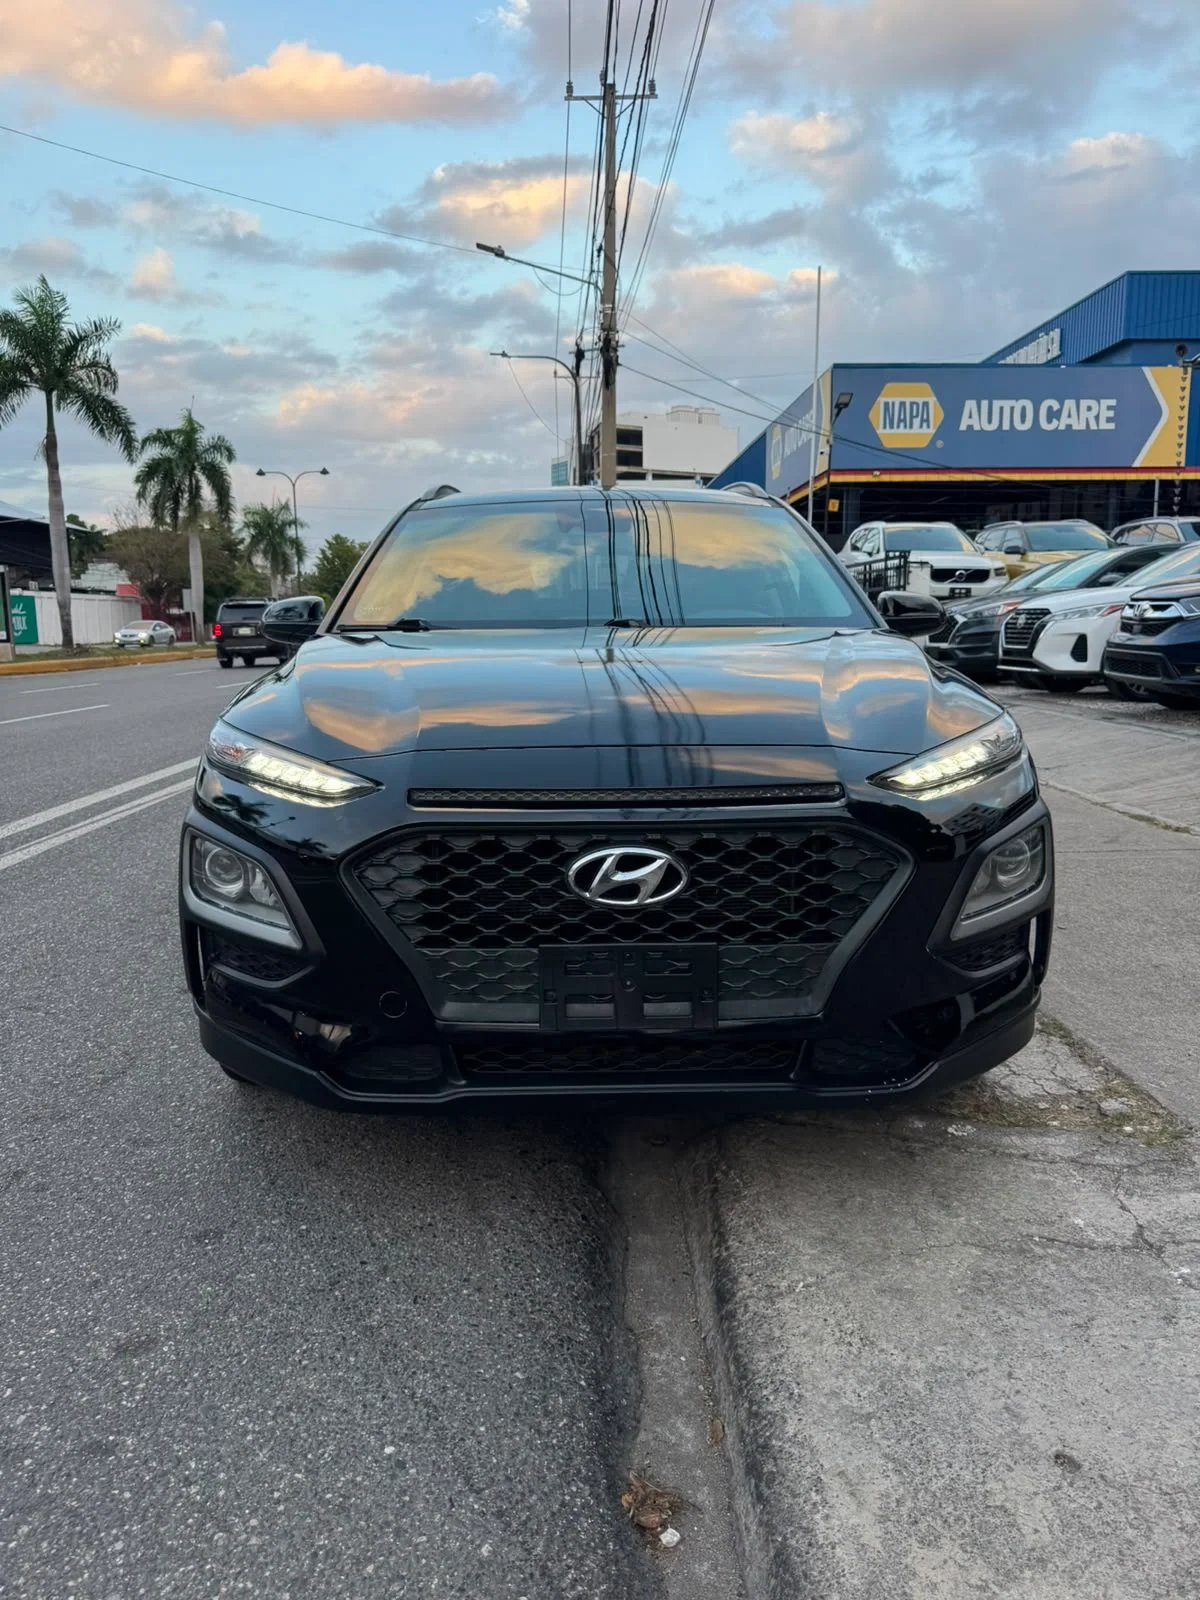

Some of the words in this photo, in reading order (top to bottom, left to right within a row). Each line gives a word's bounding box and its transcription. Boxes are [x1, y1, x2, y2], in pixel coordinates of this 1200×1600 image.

[883, 401, 931, 430] NAPA
[959, 399, 1034, 431] AUTO
[1038, 399, 1117, 431] CARE
